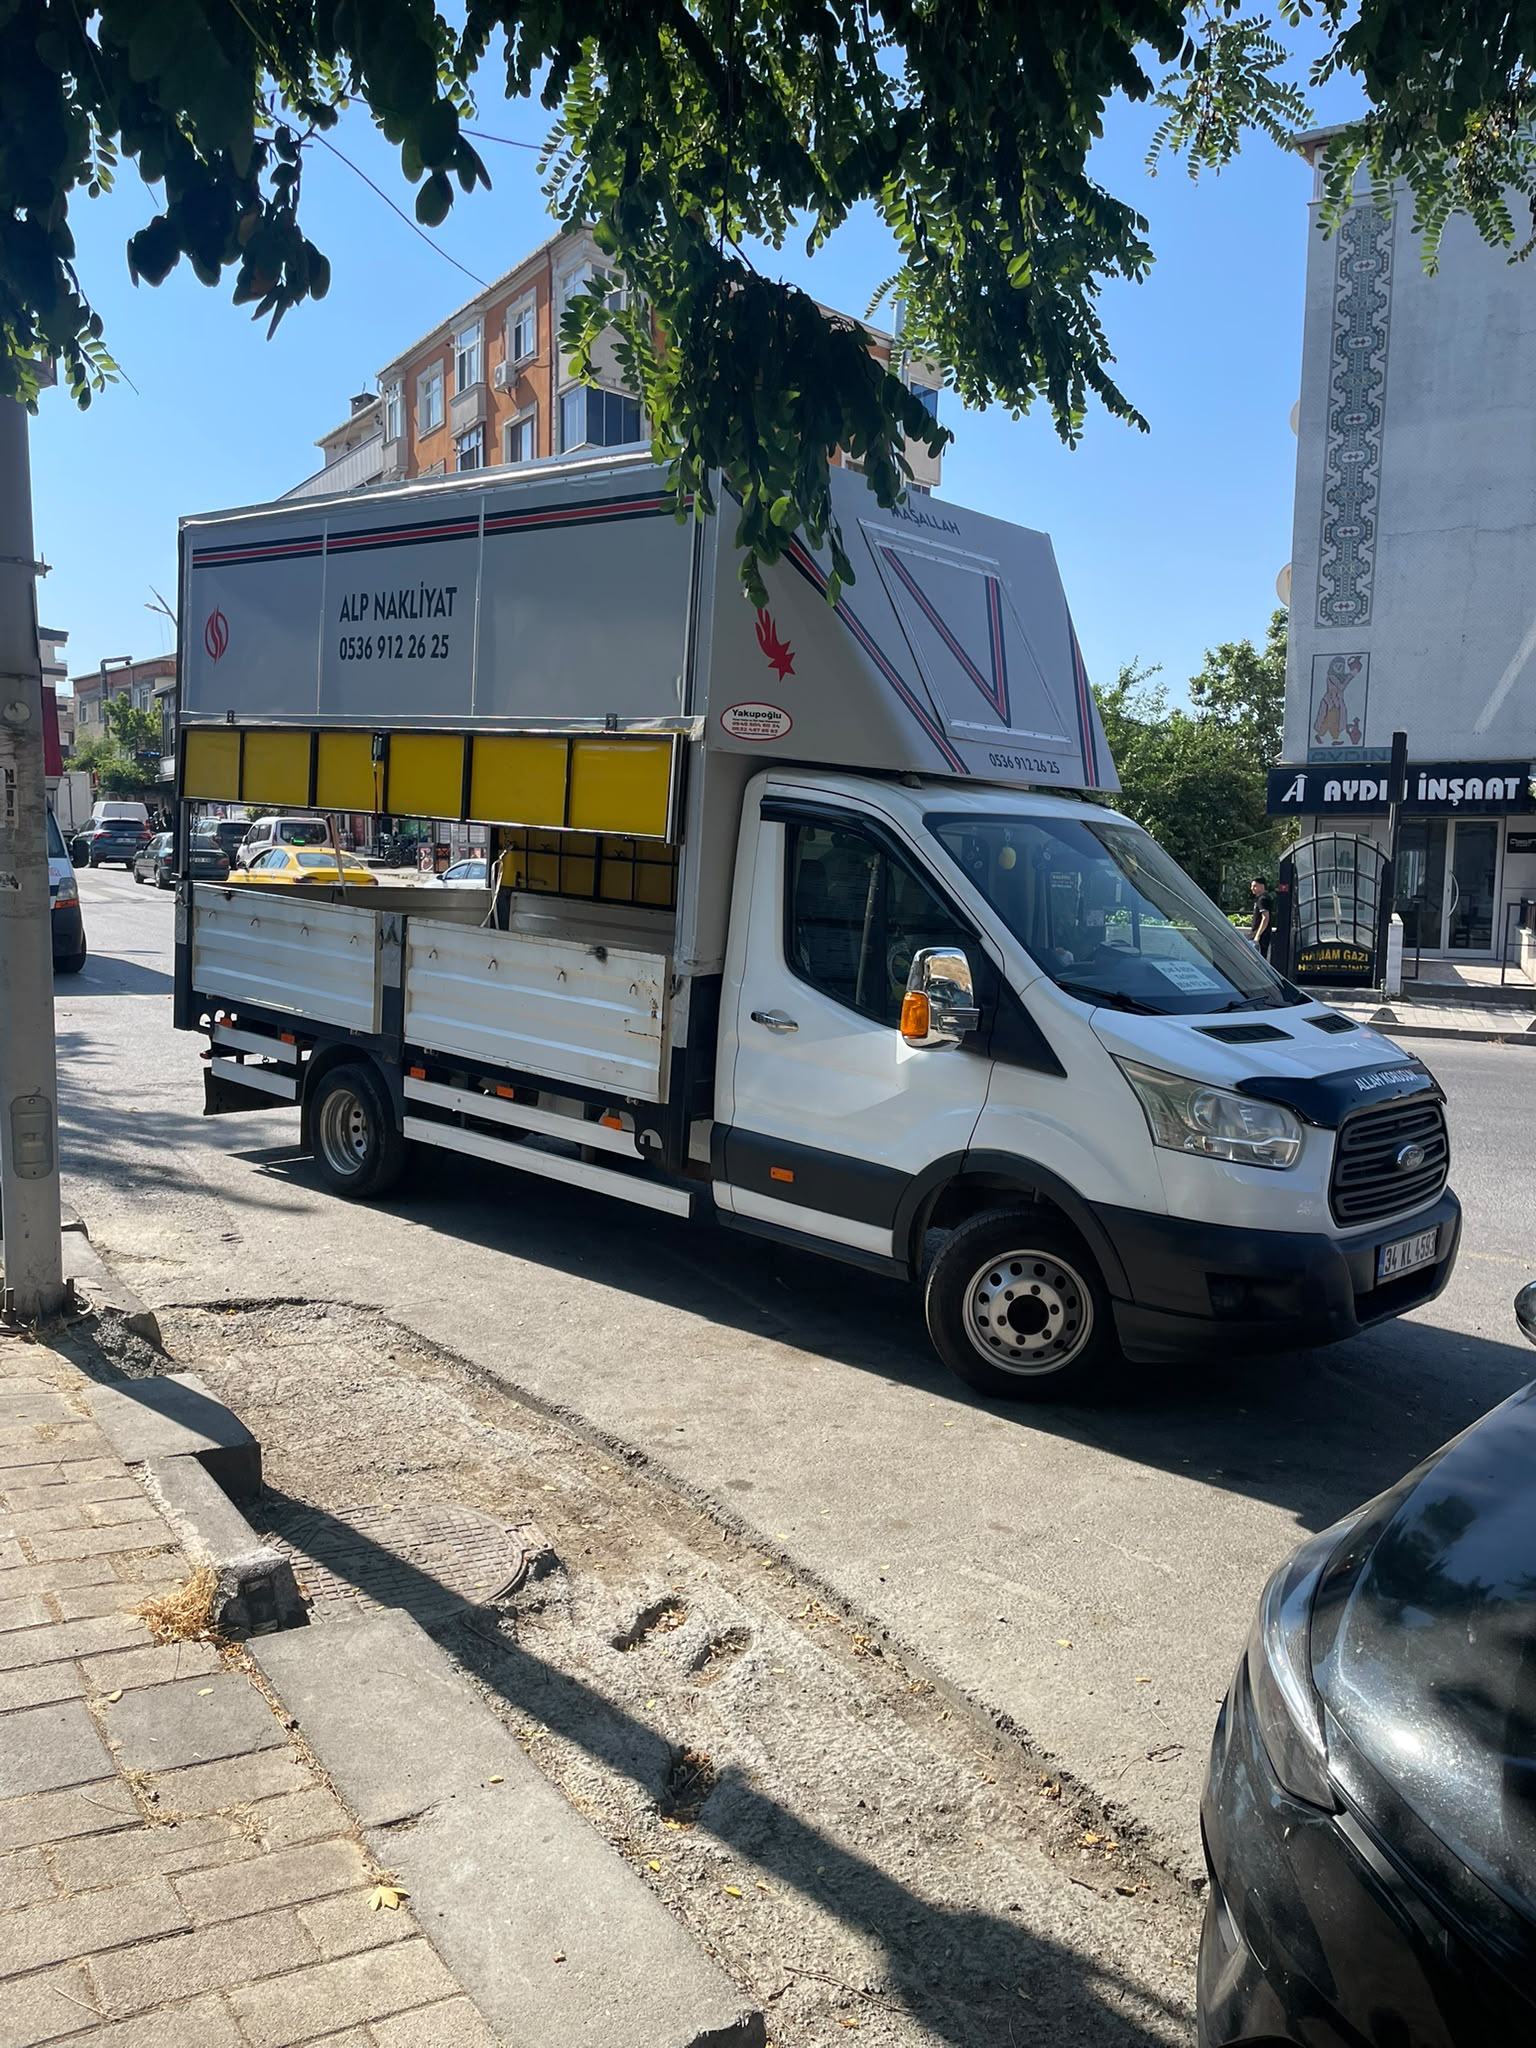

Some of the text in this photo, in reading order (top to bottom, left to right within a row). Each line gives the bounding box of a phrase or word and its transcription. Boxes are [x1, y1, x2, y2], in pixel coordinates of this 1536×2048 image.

[340, 581, 457, 622] ALP NAKLİYAT
[340, 634, 449, 660] 0536 912 26 25
[732, 709, 781, 720] Yakupoğlu
[989, 753, 1060, 774] 0536 912 26 25
[1418, 772, 1521, 806] İNŞAAT
[1354, 1073, 1385, 1091] ALLAH
[1385, 1246, 1397, 1272] 34
[1401, 1241, 1411, 1267] KL
